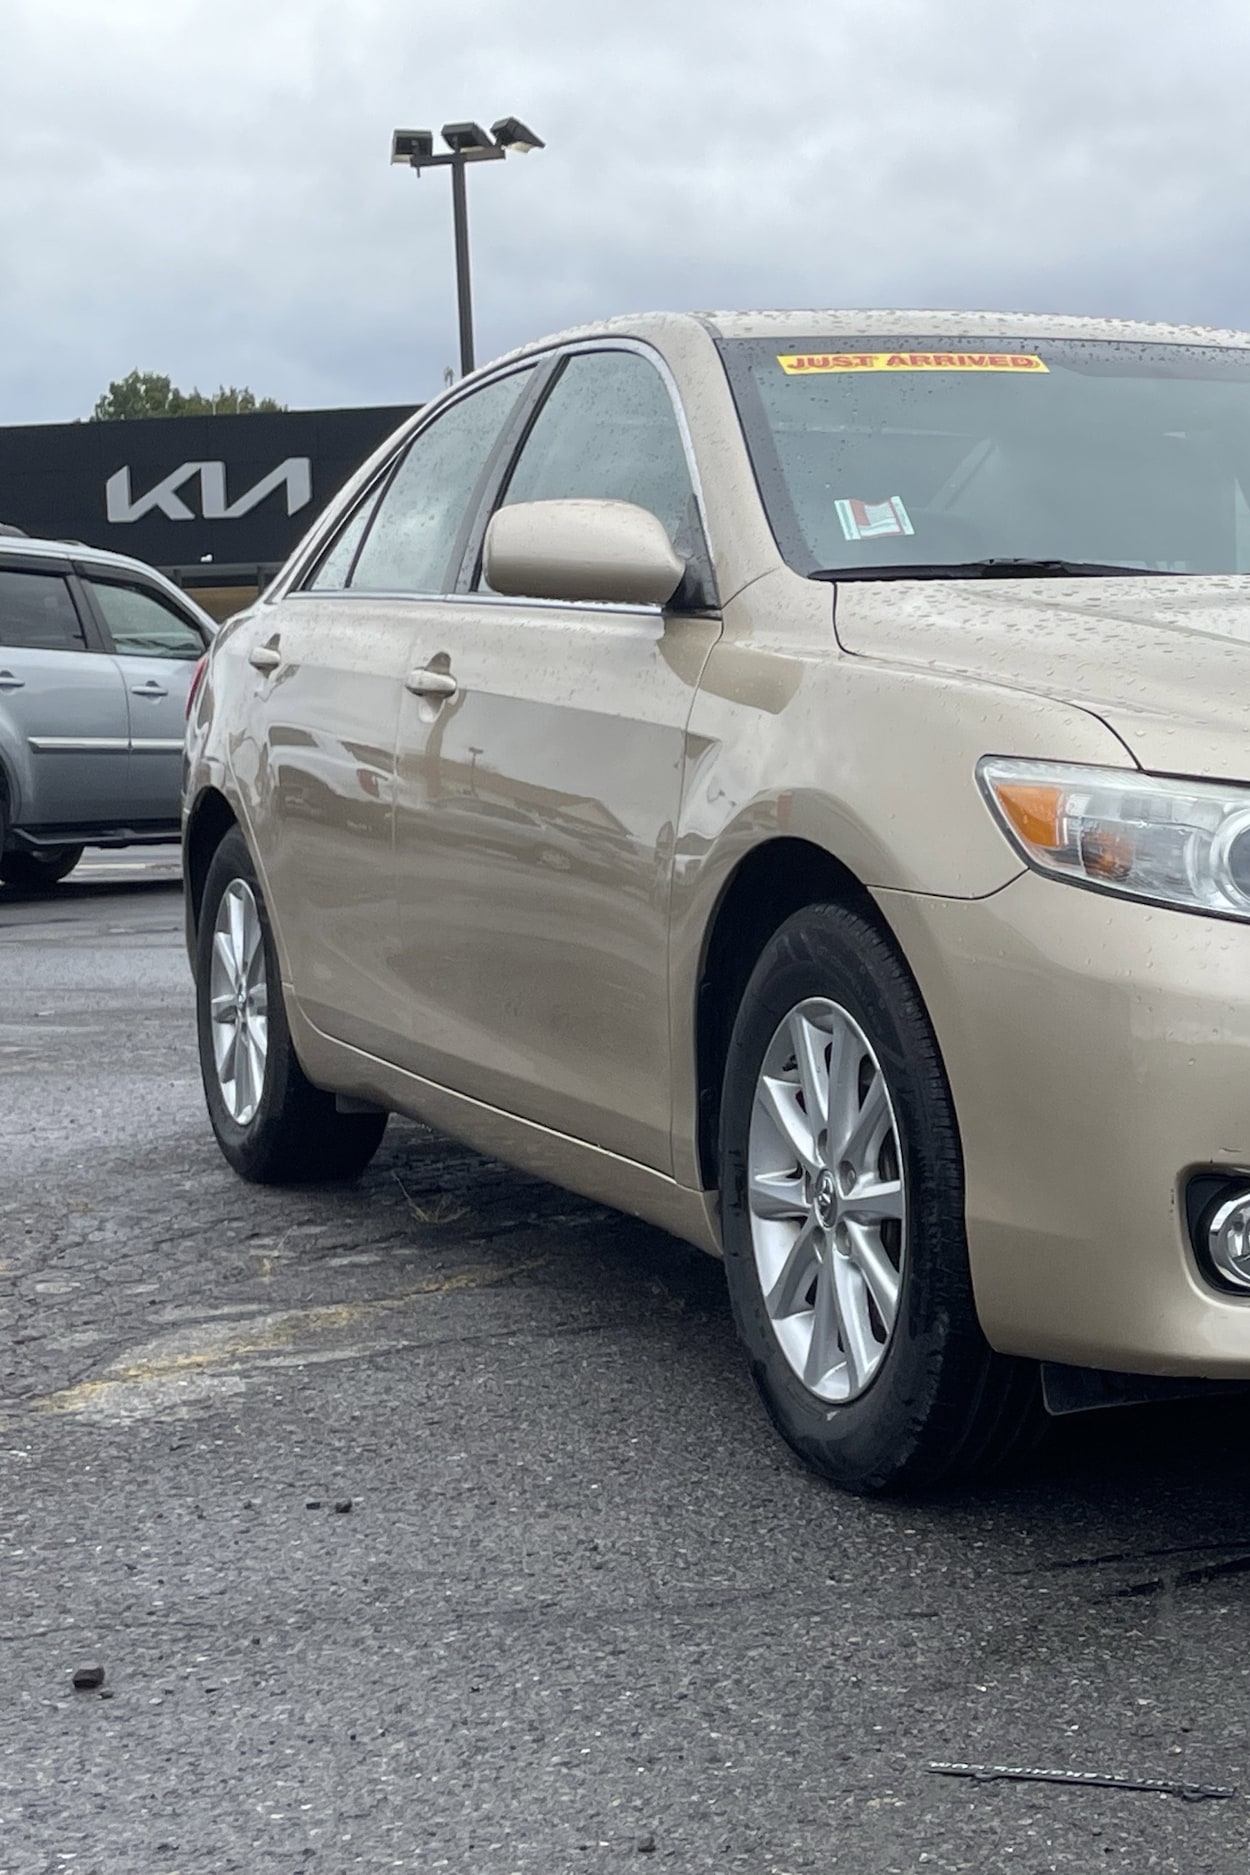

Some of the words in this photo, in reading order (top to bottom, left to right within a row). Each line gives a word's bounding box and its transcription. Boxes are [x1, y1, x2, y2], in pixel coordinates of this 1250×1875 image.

[787, 355, 877, 370] JUST
[886, 354, 1041, 369] ARRIVED
[106, 457, 312, 523] KIA
